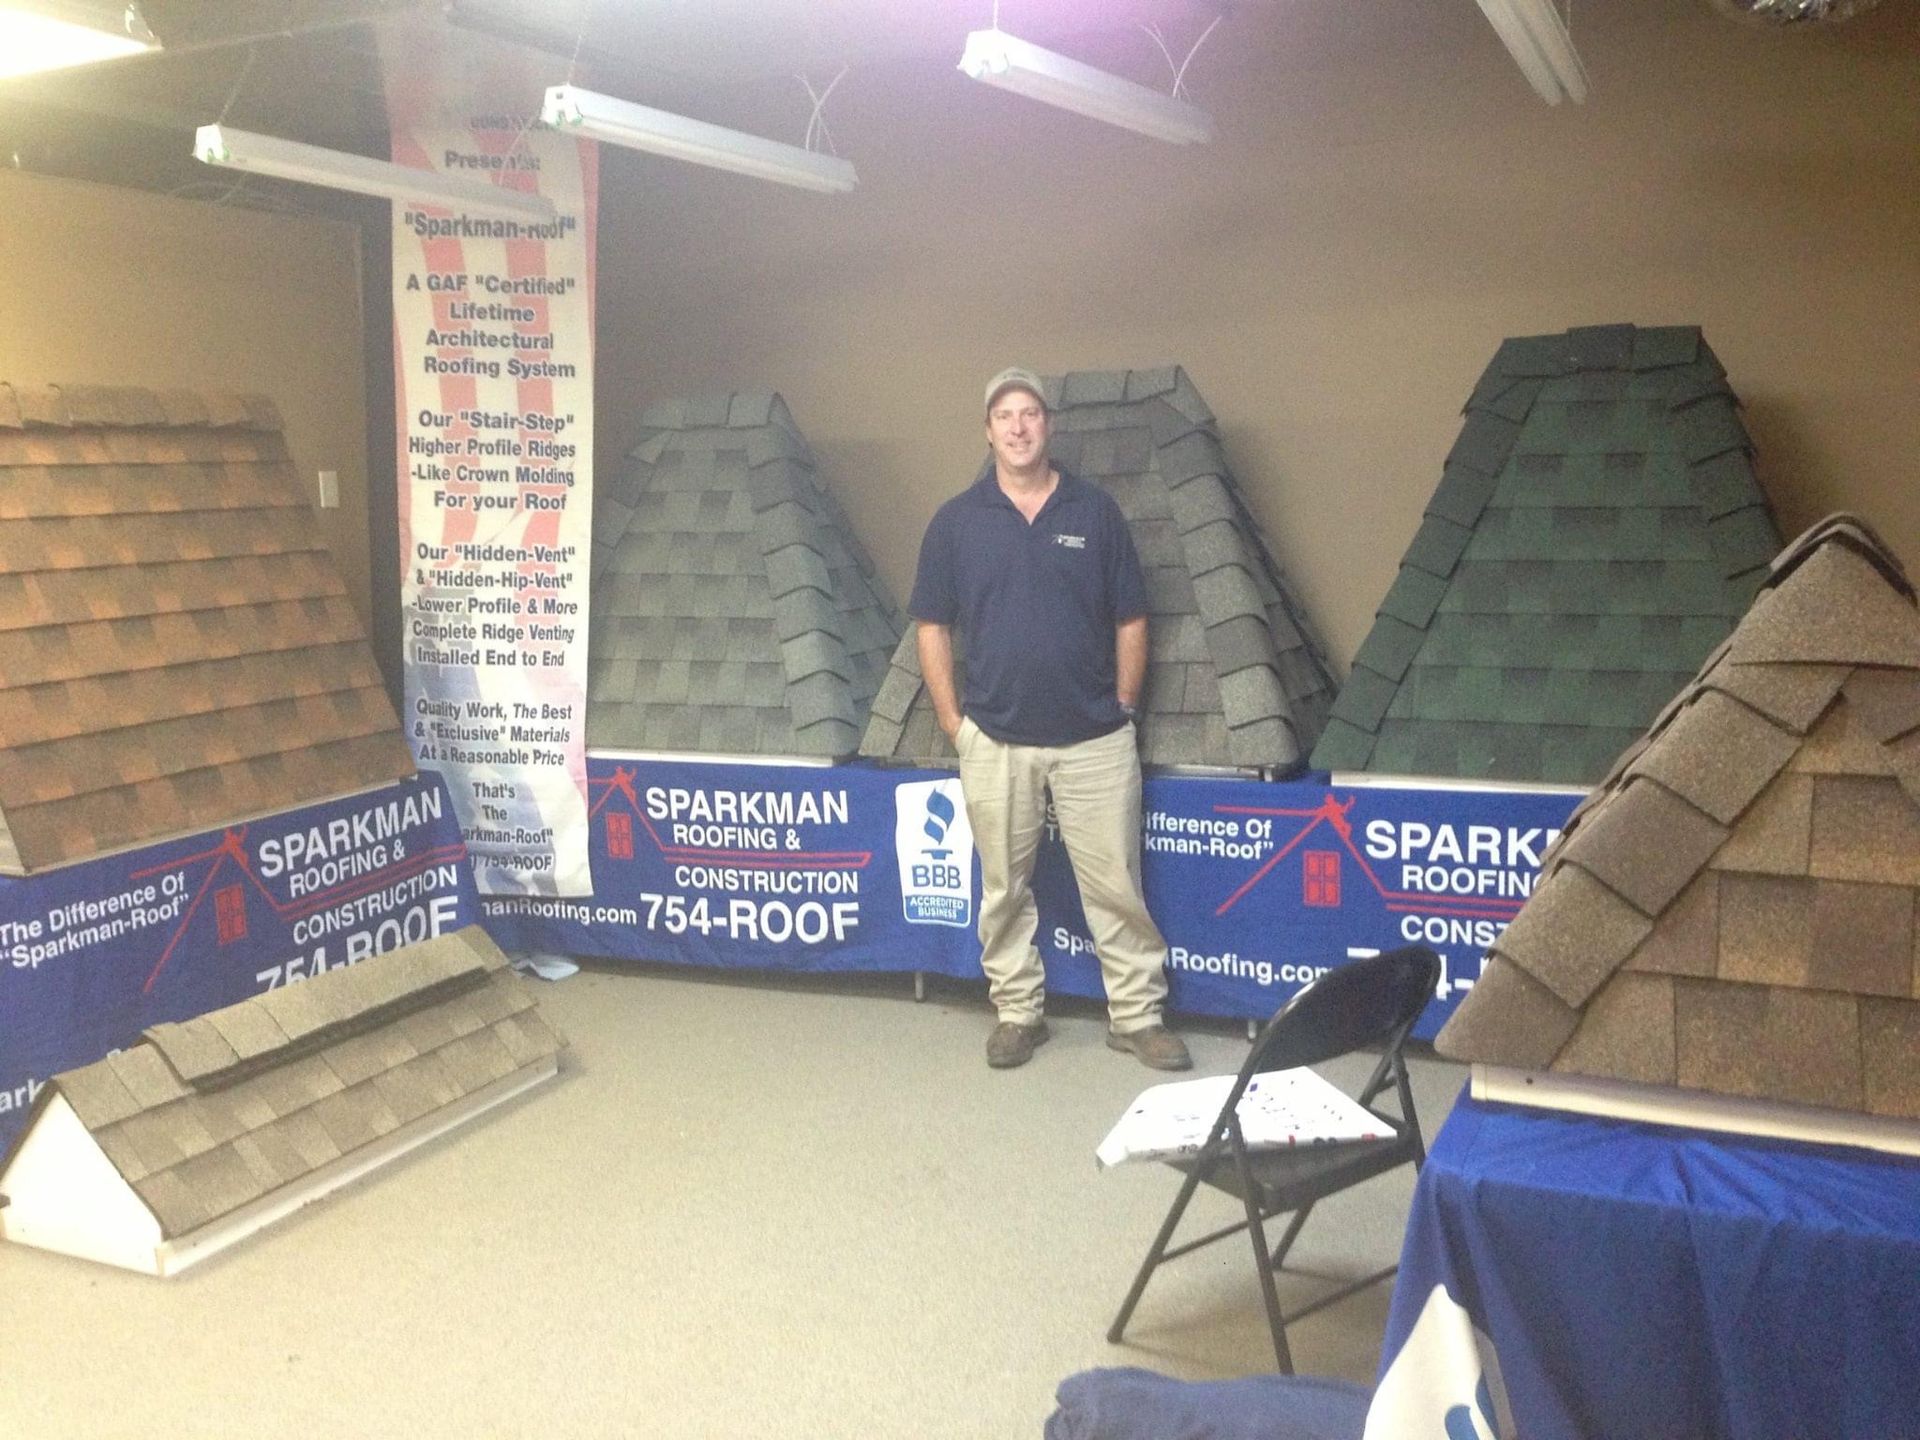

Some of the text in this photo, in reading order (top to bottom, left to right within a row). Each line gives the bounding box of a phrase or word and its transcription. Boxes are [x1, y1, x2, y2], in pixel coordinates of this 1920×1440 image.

[406, 273, 575, 296] A GAF "Certified"
[449, 302, 535, 322] Lifetime
[426, 329, 554, 350] Architectural
[424, 356, 576, 380] Roofing System
[418, 410, 574, 434] Our "Stair-Step"
[408, 436, 576, 461] Higher Profile Ridges
[411, 465, 575, 487] -Like Crown Molding
[434, 490, 567, 512] For your Roof
[417, 543, 576, 563] Our "Hidden-Vent"
[416, 569, 573, 591] & "Hidden-Hip-Vent"
[411, 595, 578, 615] -Lower Profile & More
[413, 621, 575, 644] Complete Ridge Venting
[417, 647, 565, 667] Installed End to End
[417, 699, 572, 721] Quality Work, The Best
[414, 722, 570, 743] & "Exclusive" Materials
[419, 745, 565, 766] At a Reasonable Price
[472, 782, 516, 799] That's
[482, 805, 507, 821] The
[645, 786, 849, 824] SPARKMAN
[258, 786, 442, 879] SPARKMAN
[673, 824, 801, 850] ROOFING &
[1244, 818, 1272, 840] Of
[289, 838, 406, 899] ROOFING &
[675, 865, 859, 894] CONSTRUCTION
[911, 864, 962, 889] BBB
[0, 871, 186, 947] The Difference Of
[293, 864, 458, 946] CONSTRUCTION
[910, 897, 964, 910] ACCREDITED
[918, 906, 957, 920] BUSINESS
[639, 892, 860, 943] 754-ROOF
